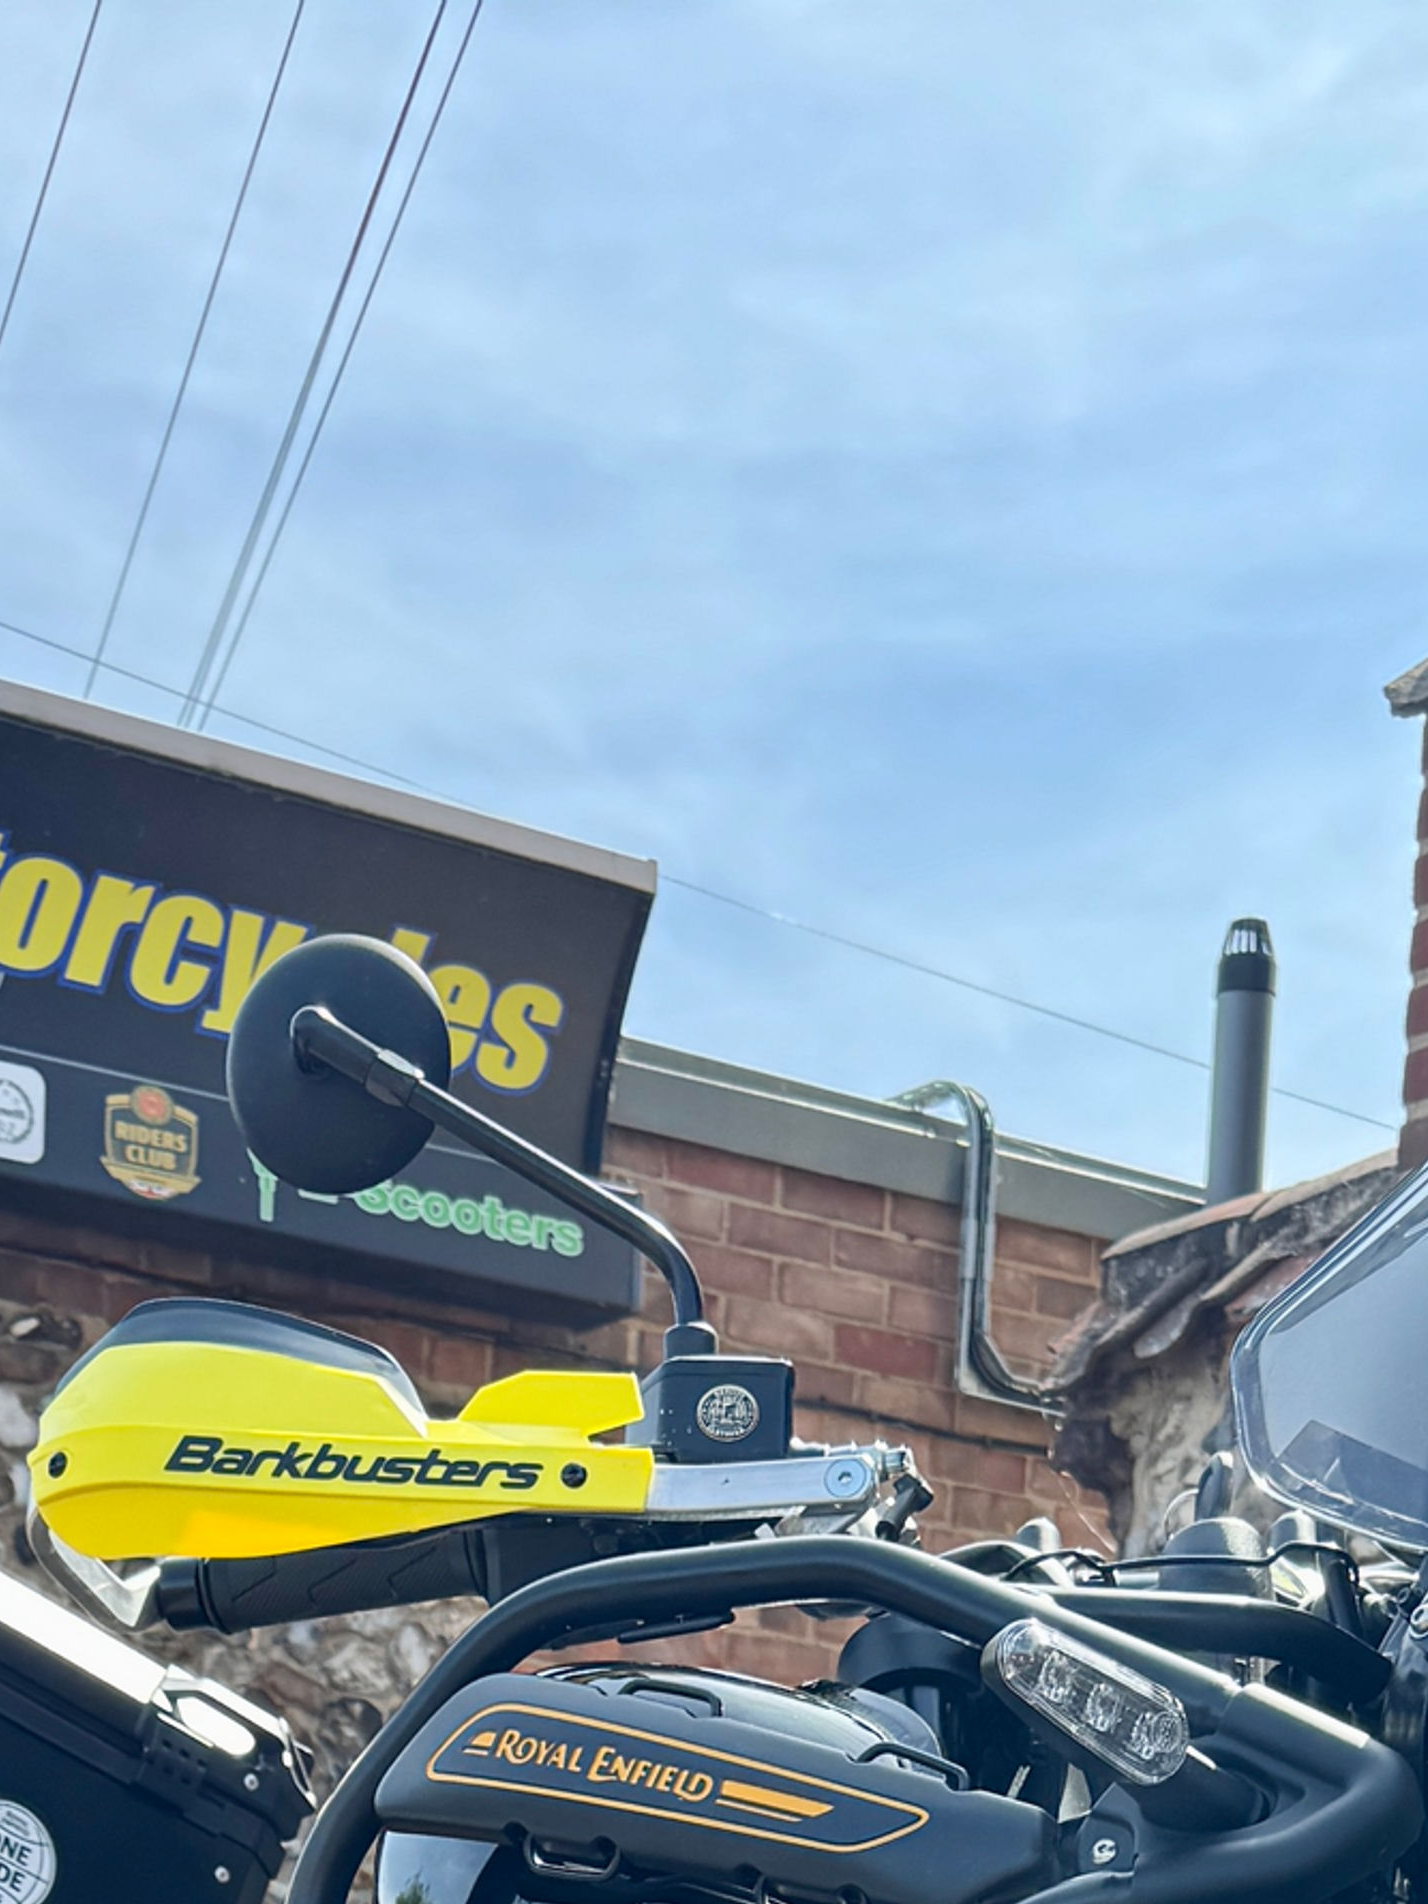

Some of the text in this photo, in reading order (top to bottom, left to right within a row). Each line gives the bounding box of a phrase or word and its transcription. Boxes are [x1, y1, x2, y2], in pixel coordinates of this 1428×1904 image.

[115, 1120, 187, 1153] RIDERS
[124, 1144, 177, 1171] CLUB
[164, 1435, 543, 1490] Barkbusters
[494, 1729, 713, 1801] ROYAL ENFIELD
